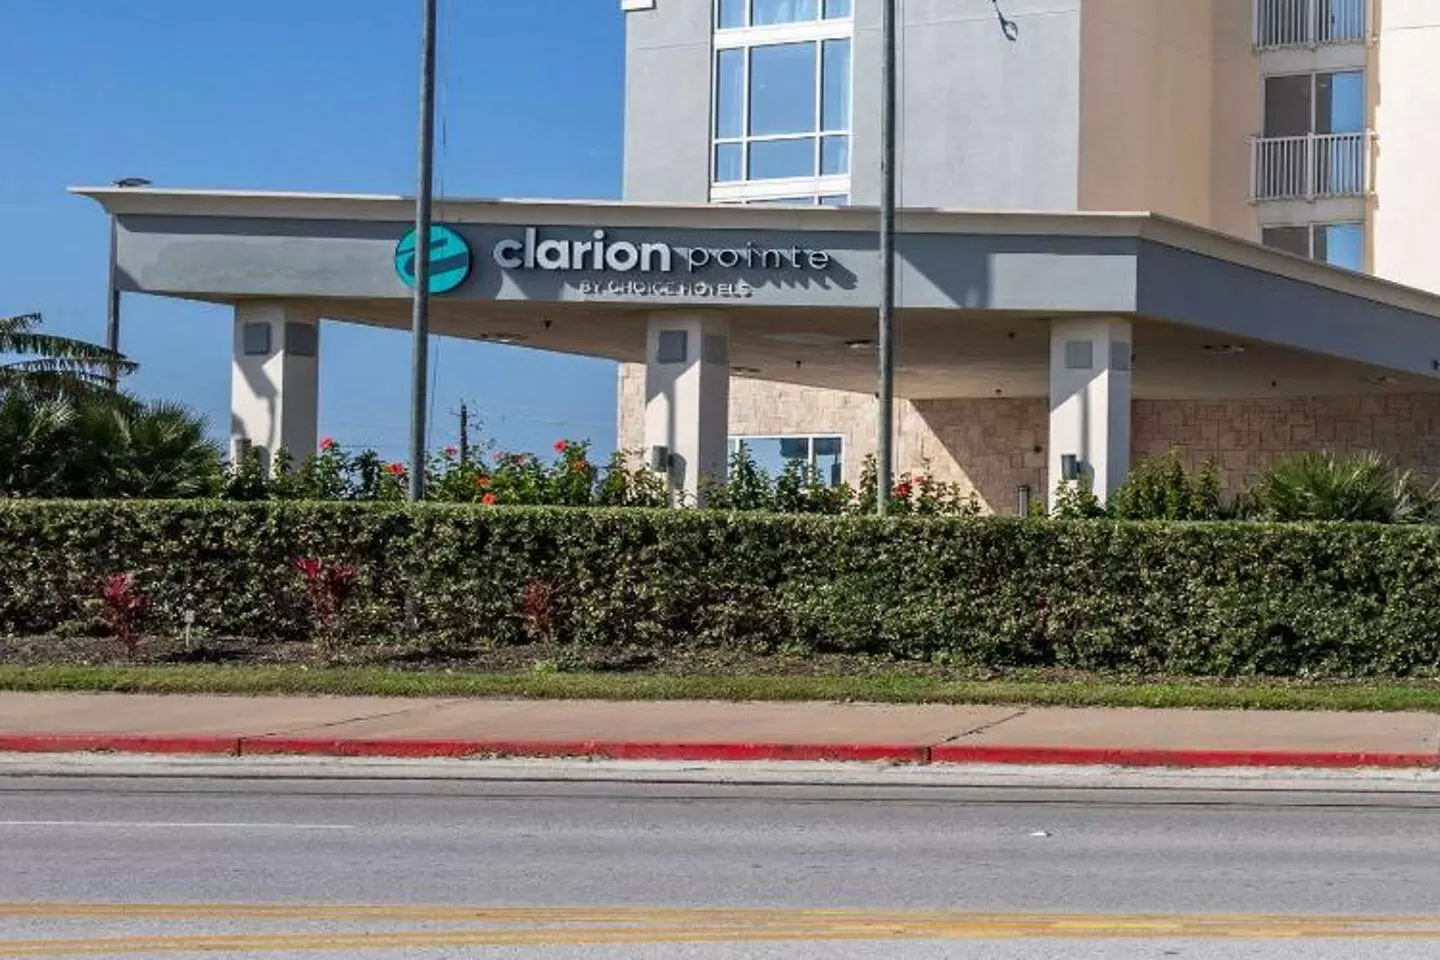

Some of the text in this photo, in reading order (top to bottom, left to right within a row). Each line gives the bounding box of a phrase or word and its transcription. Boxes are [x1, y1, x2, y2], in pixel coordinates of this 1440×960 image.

[492, 227, 830, 275] clarion pointe
[578, 280, 753, 298] BY CHOICE HOTELS
